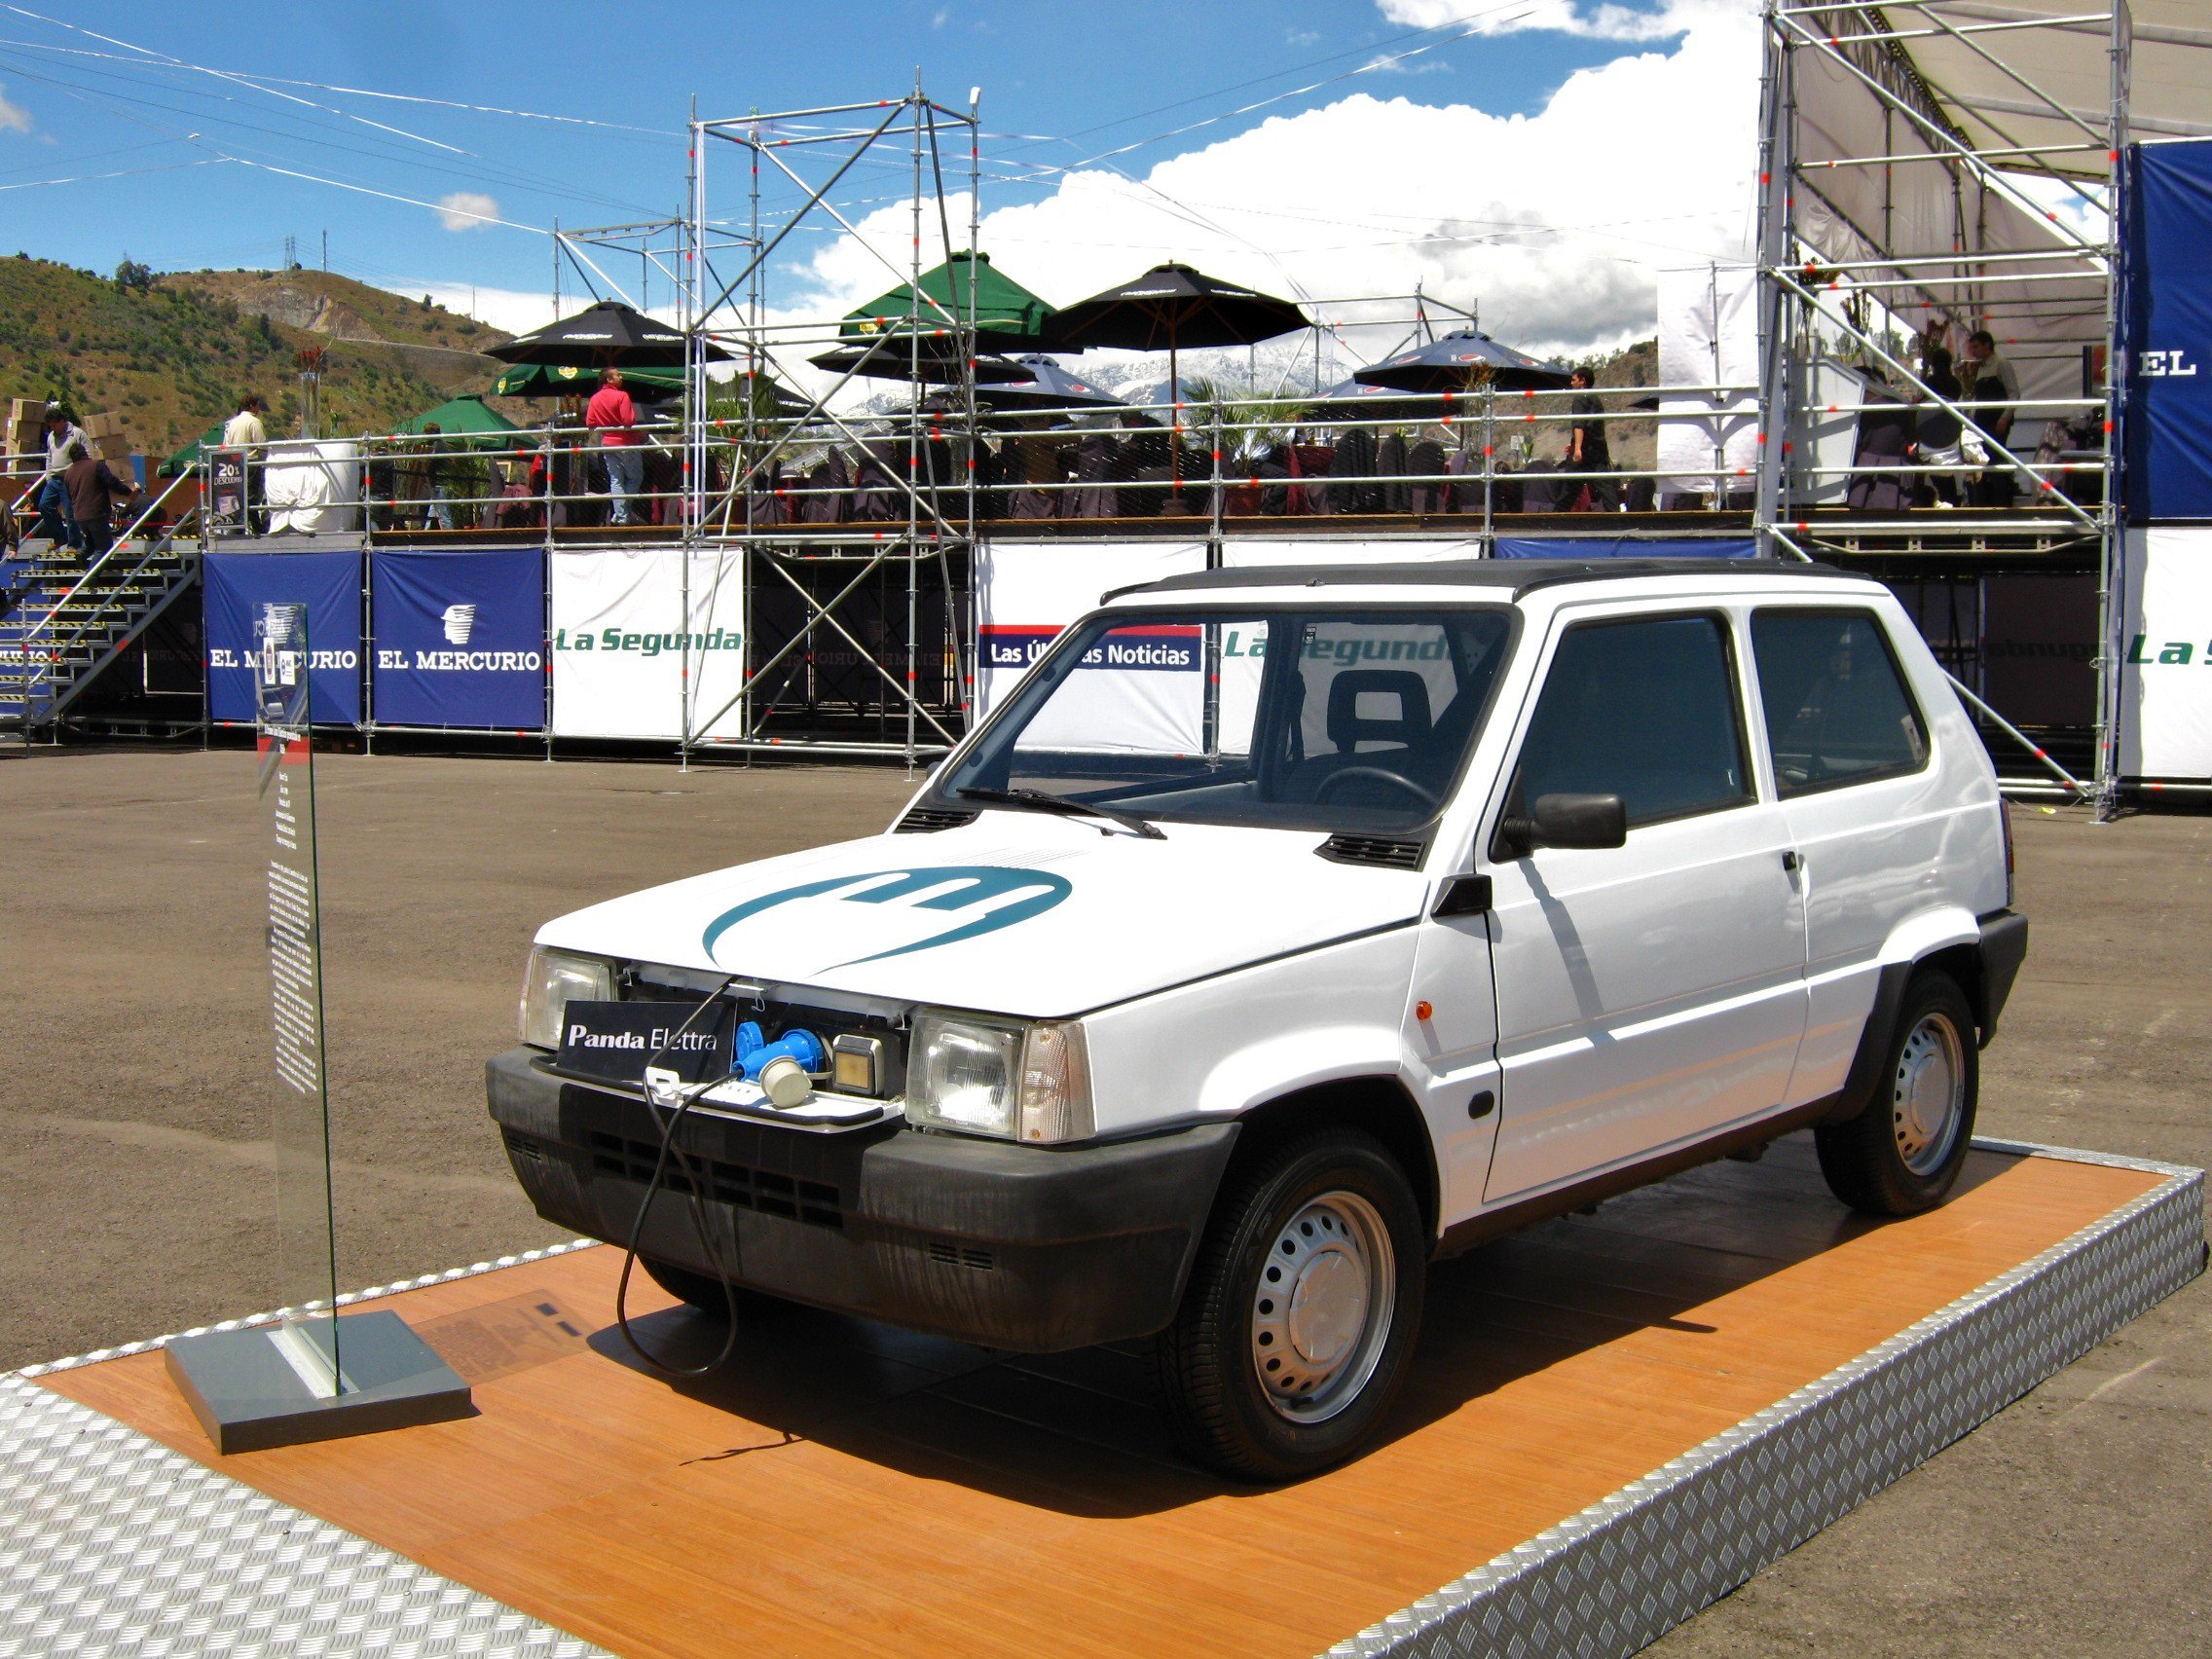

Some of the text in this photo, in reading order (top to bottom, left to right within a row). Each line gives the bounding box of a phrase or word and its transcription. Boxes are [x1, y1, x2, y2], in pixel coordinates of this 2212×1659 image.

[2138, 350, 2197, 377] EL
[218, 462, 240, 477] 20%
[555, 628, 742, 656] La Segunda
[990, 643, 1022, 663] Las
[1107, 644, 1190, 666] Noticias
[2126, 634, 2194, 665] La
[209, 648, 239, 668] EL
[377, 648, 541, 672] EL MERCURIO
[568, 1024, 718, 1051] Panda Elettra
